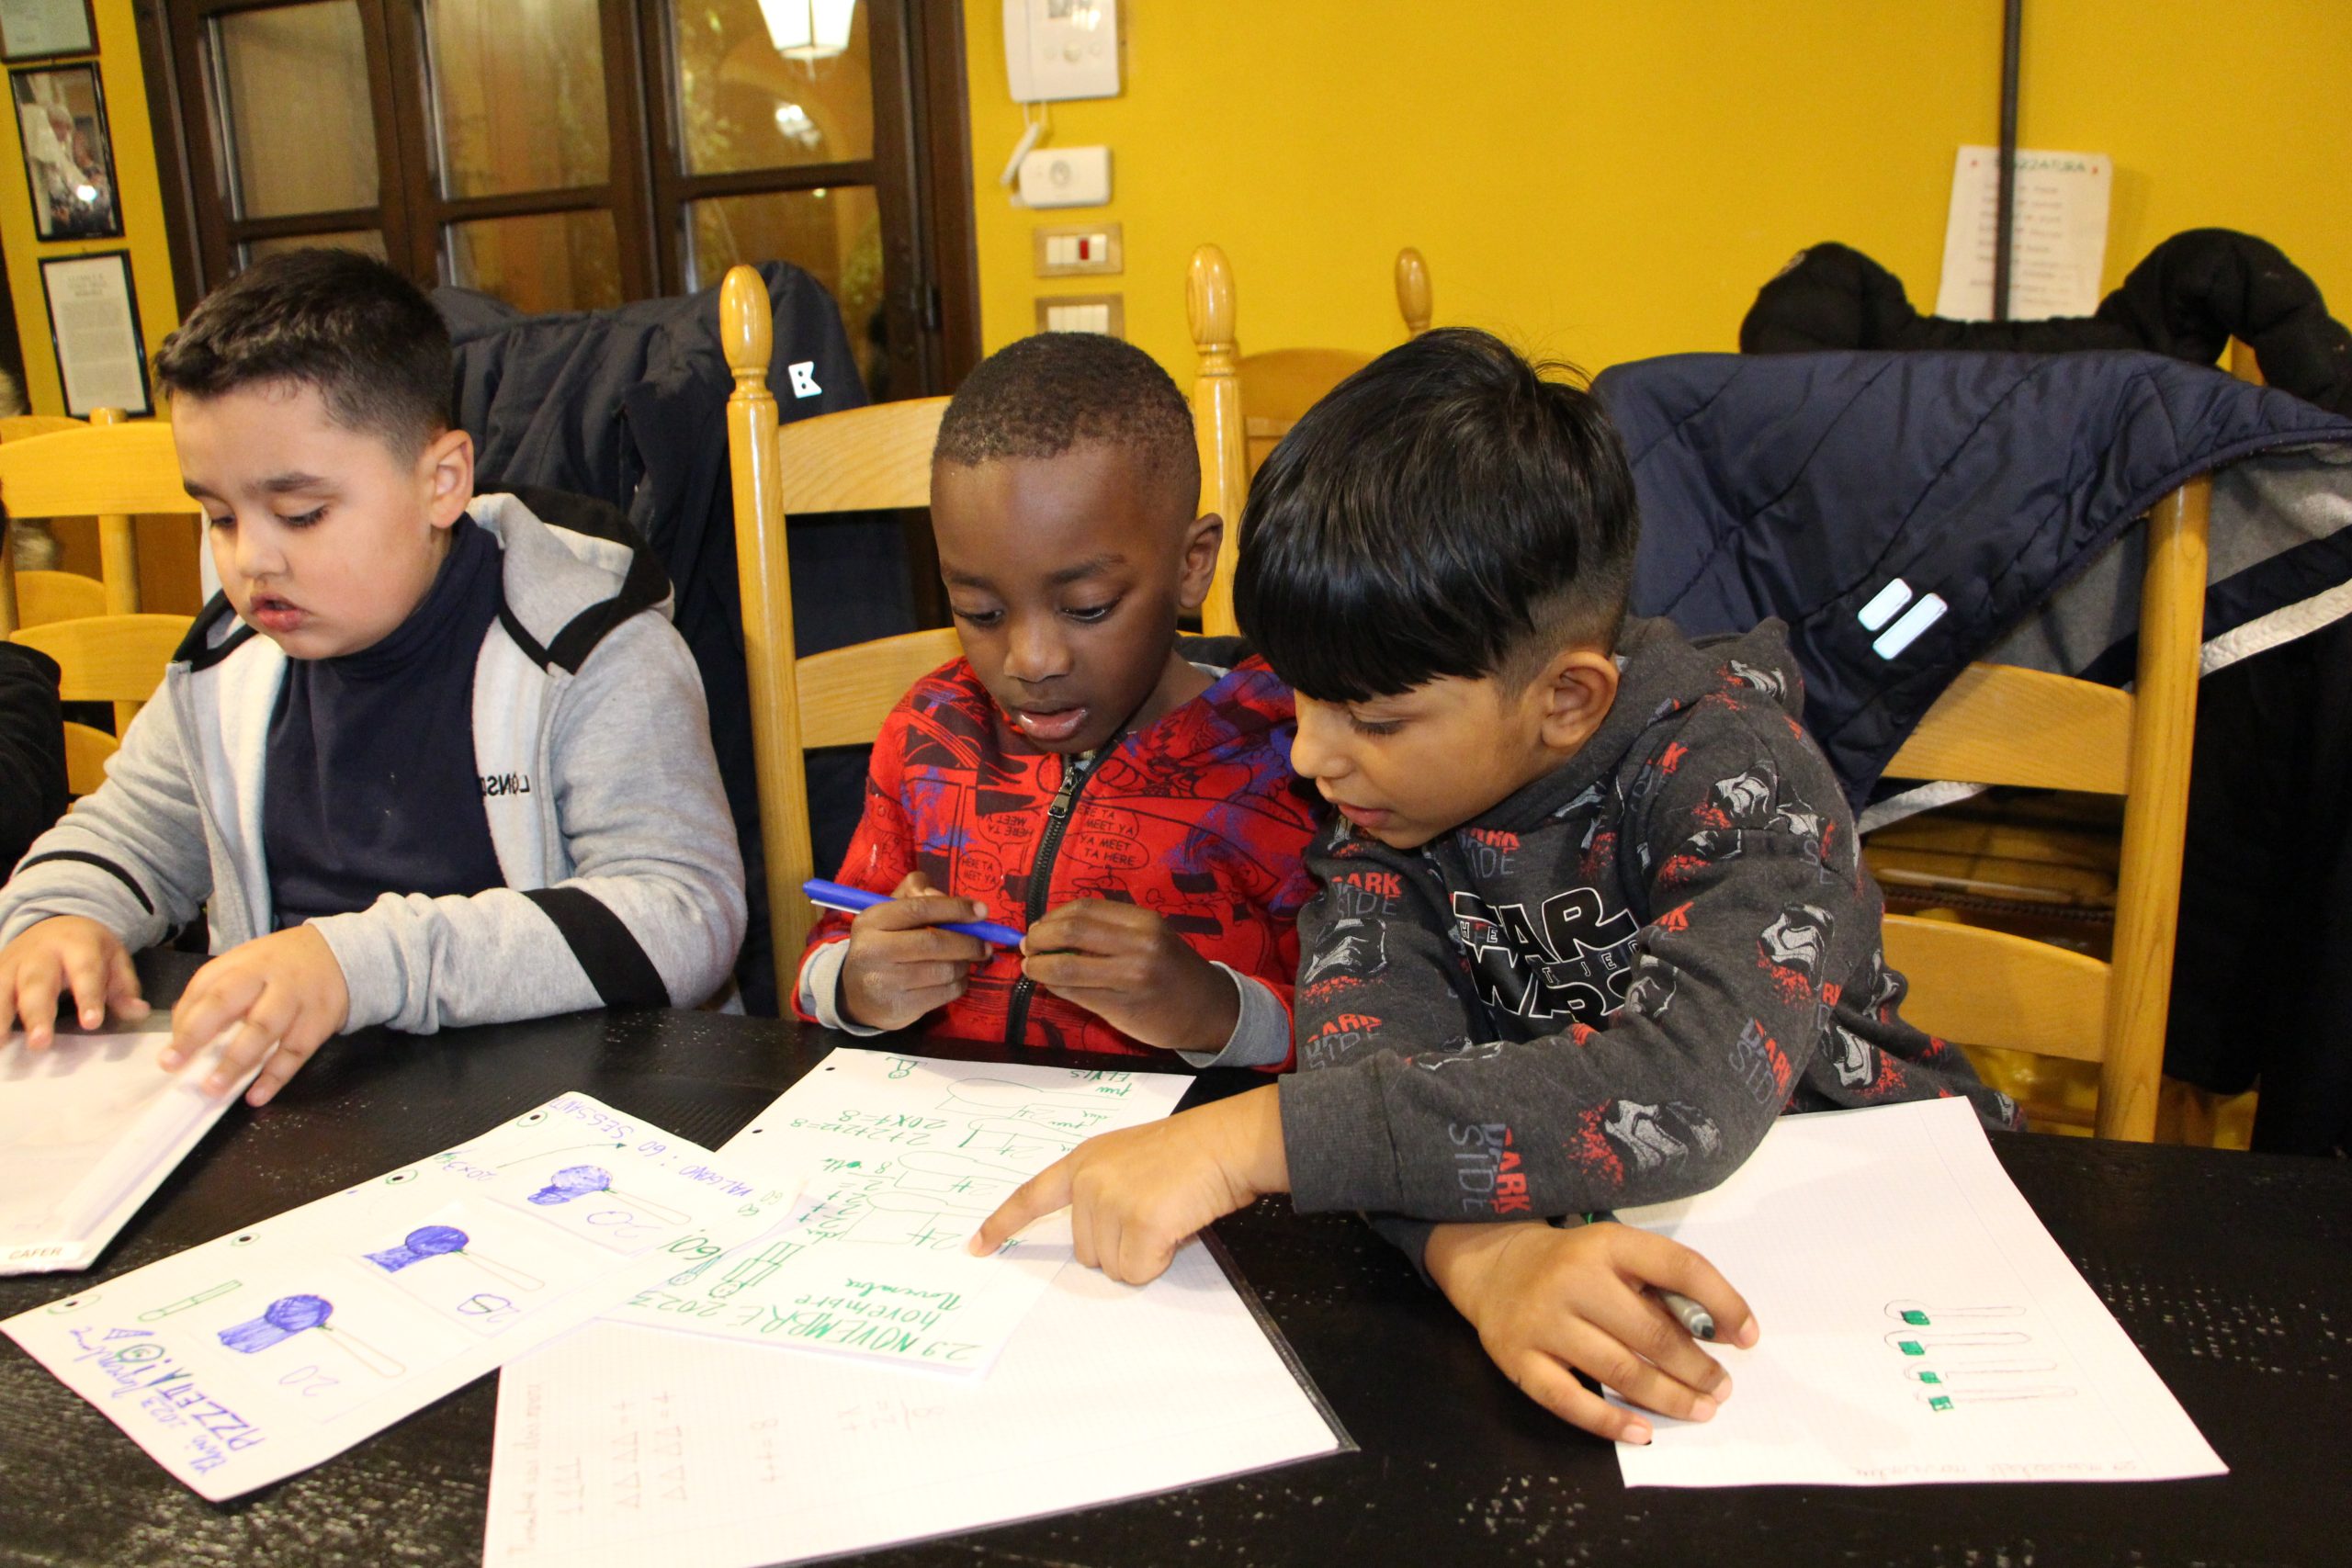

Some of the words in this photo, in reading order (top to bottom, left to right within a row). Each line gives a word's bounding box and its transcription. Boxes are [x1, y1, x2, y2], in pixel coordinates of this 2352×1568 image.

[1080, 834, 1094, 846] YA
[1099, 838, 1132, 852] MEET
[1085, 847, 1099, 859] TA
[1103, 852, 1136, 866] HERE
[727, 1304, 922, 1353] NOVEMBRE
